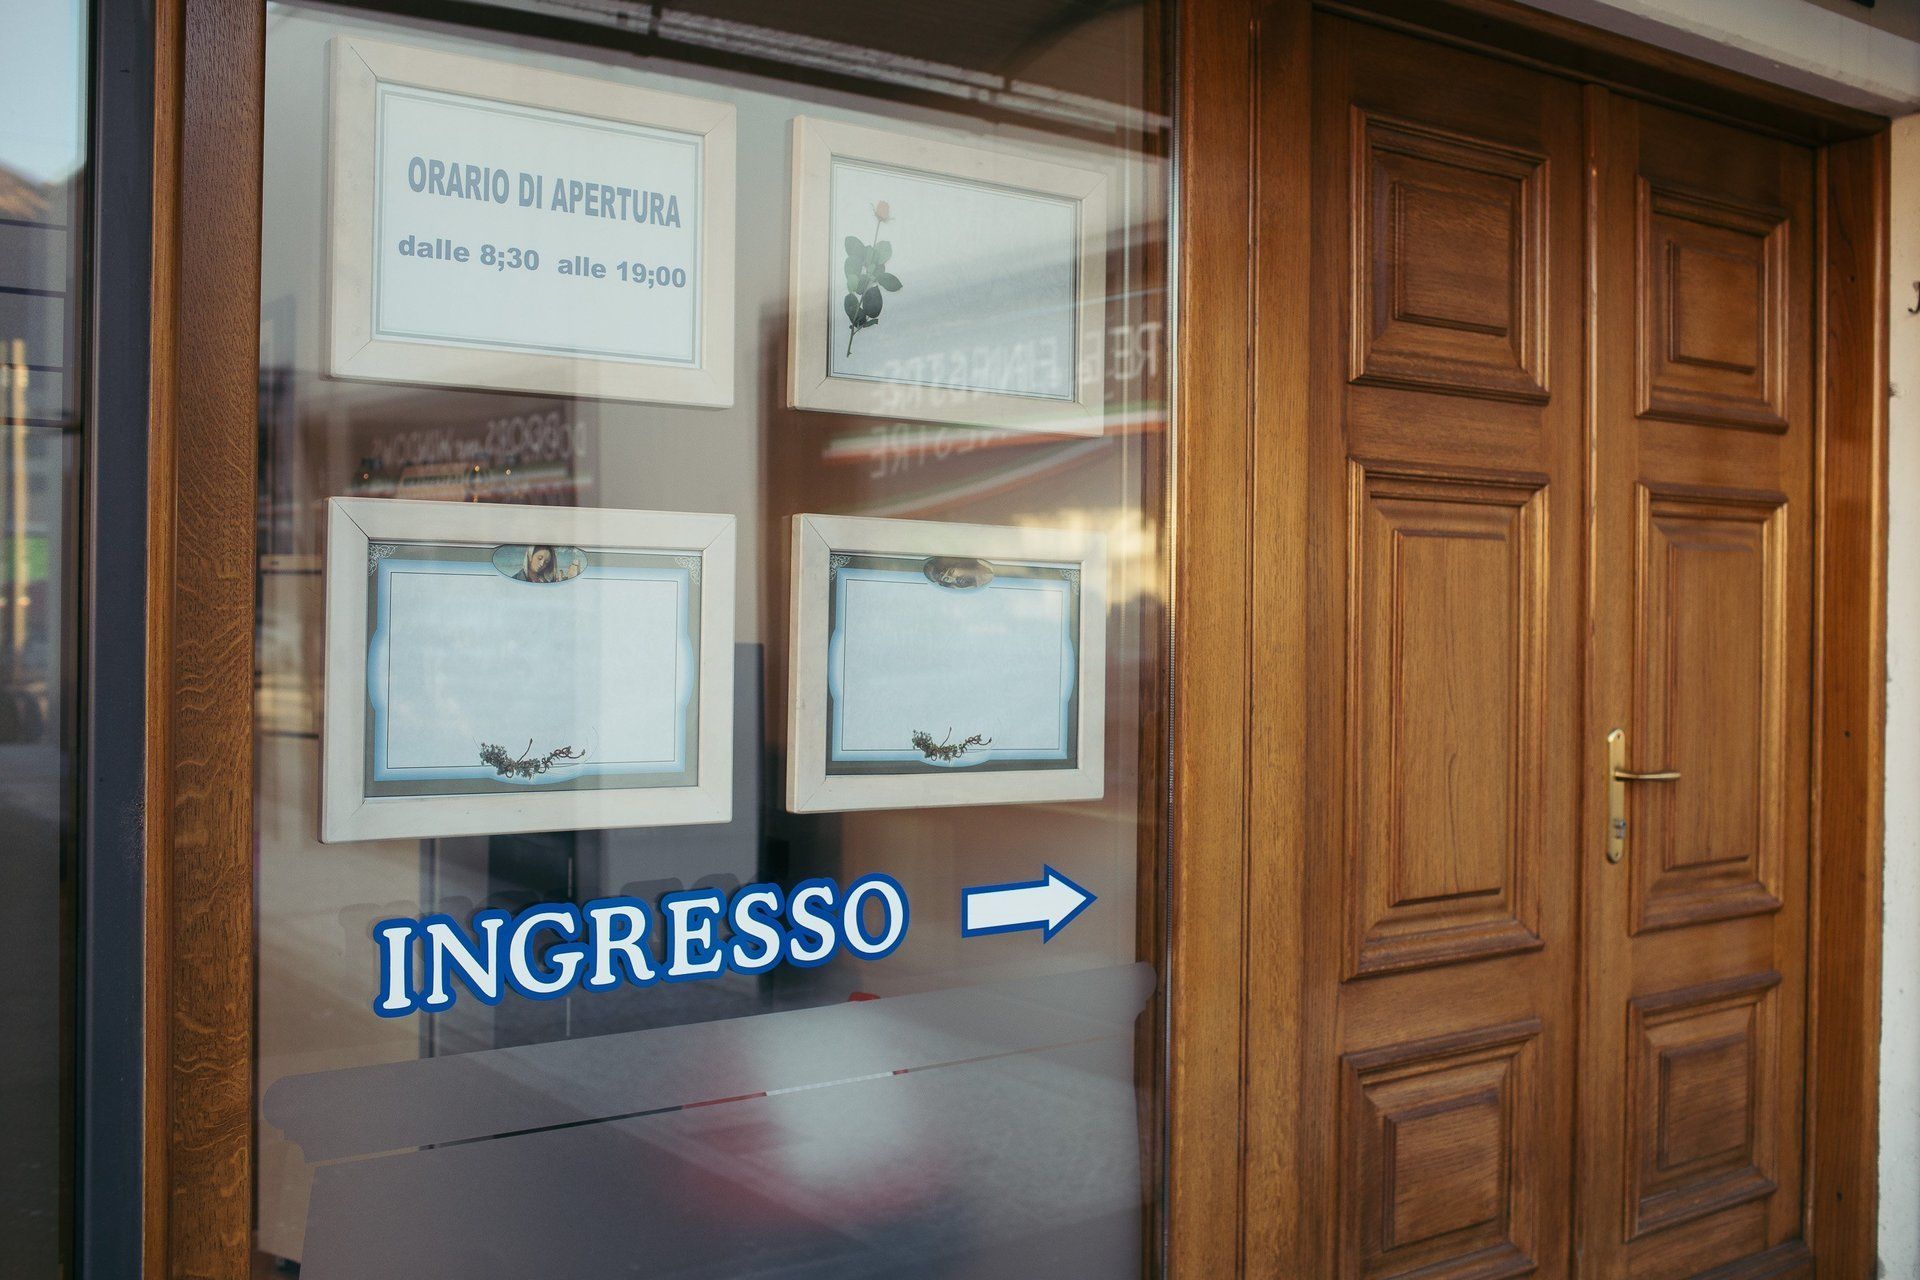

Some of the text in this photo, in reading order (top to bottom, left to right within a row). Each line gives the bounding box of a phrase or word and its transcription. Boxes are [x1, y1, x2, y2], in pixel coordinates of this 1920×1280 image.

[408, 156, 681, 229] ORARIO DI APERTURA
[398, 235, 687, 290] dalle 8;30 alle 19;00
[375, 873, 909, 1016] INGRESSO
